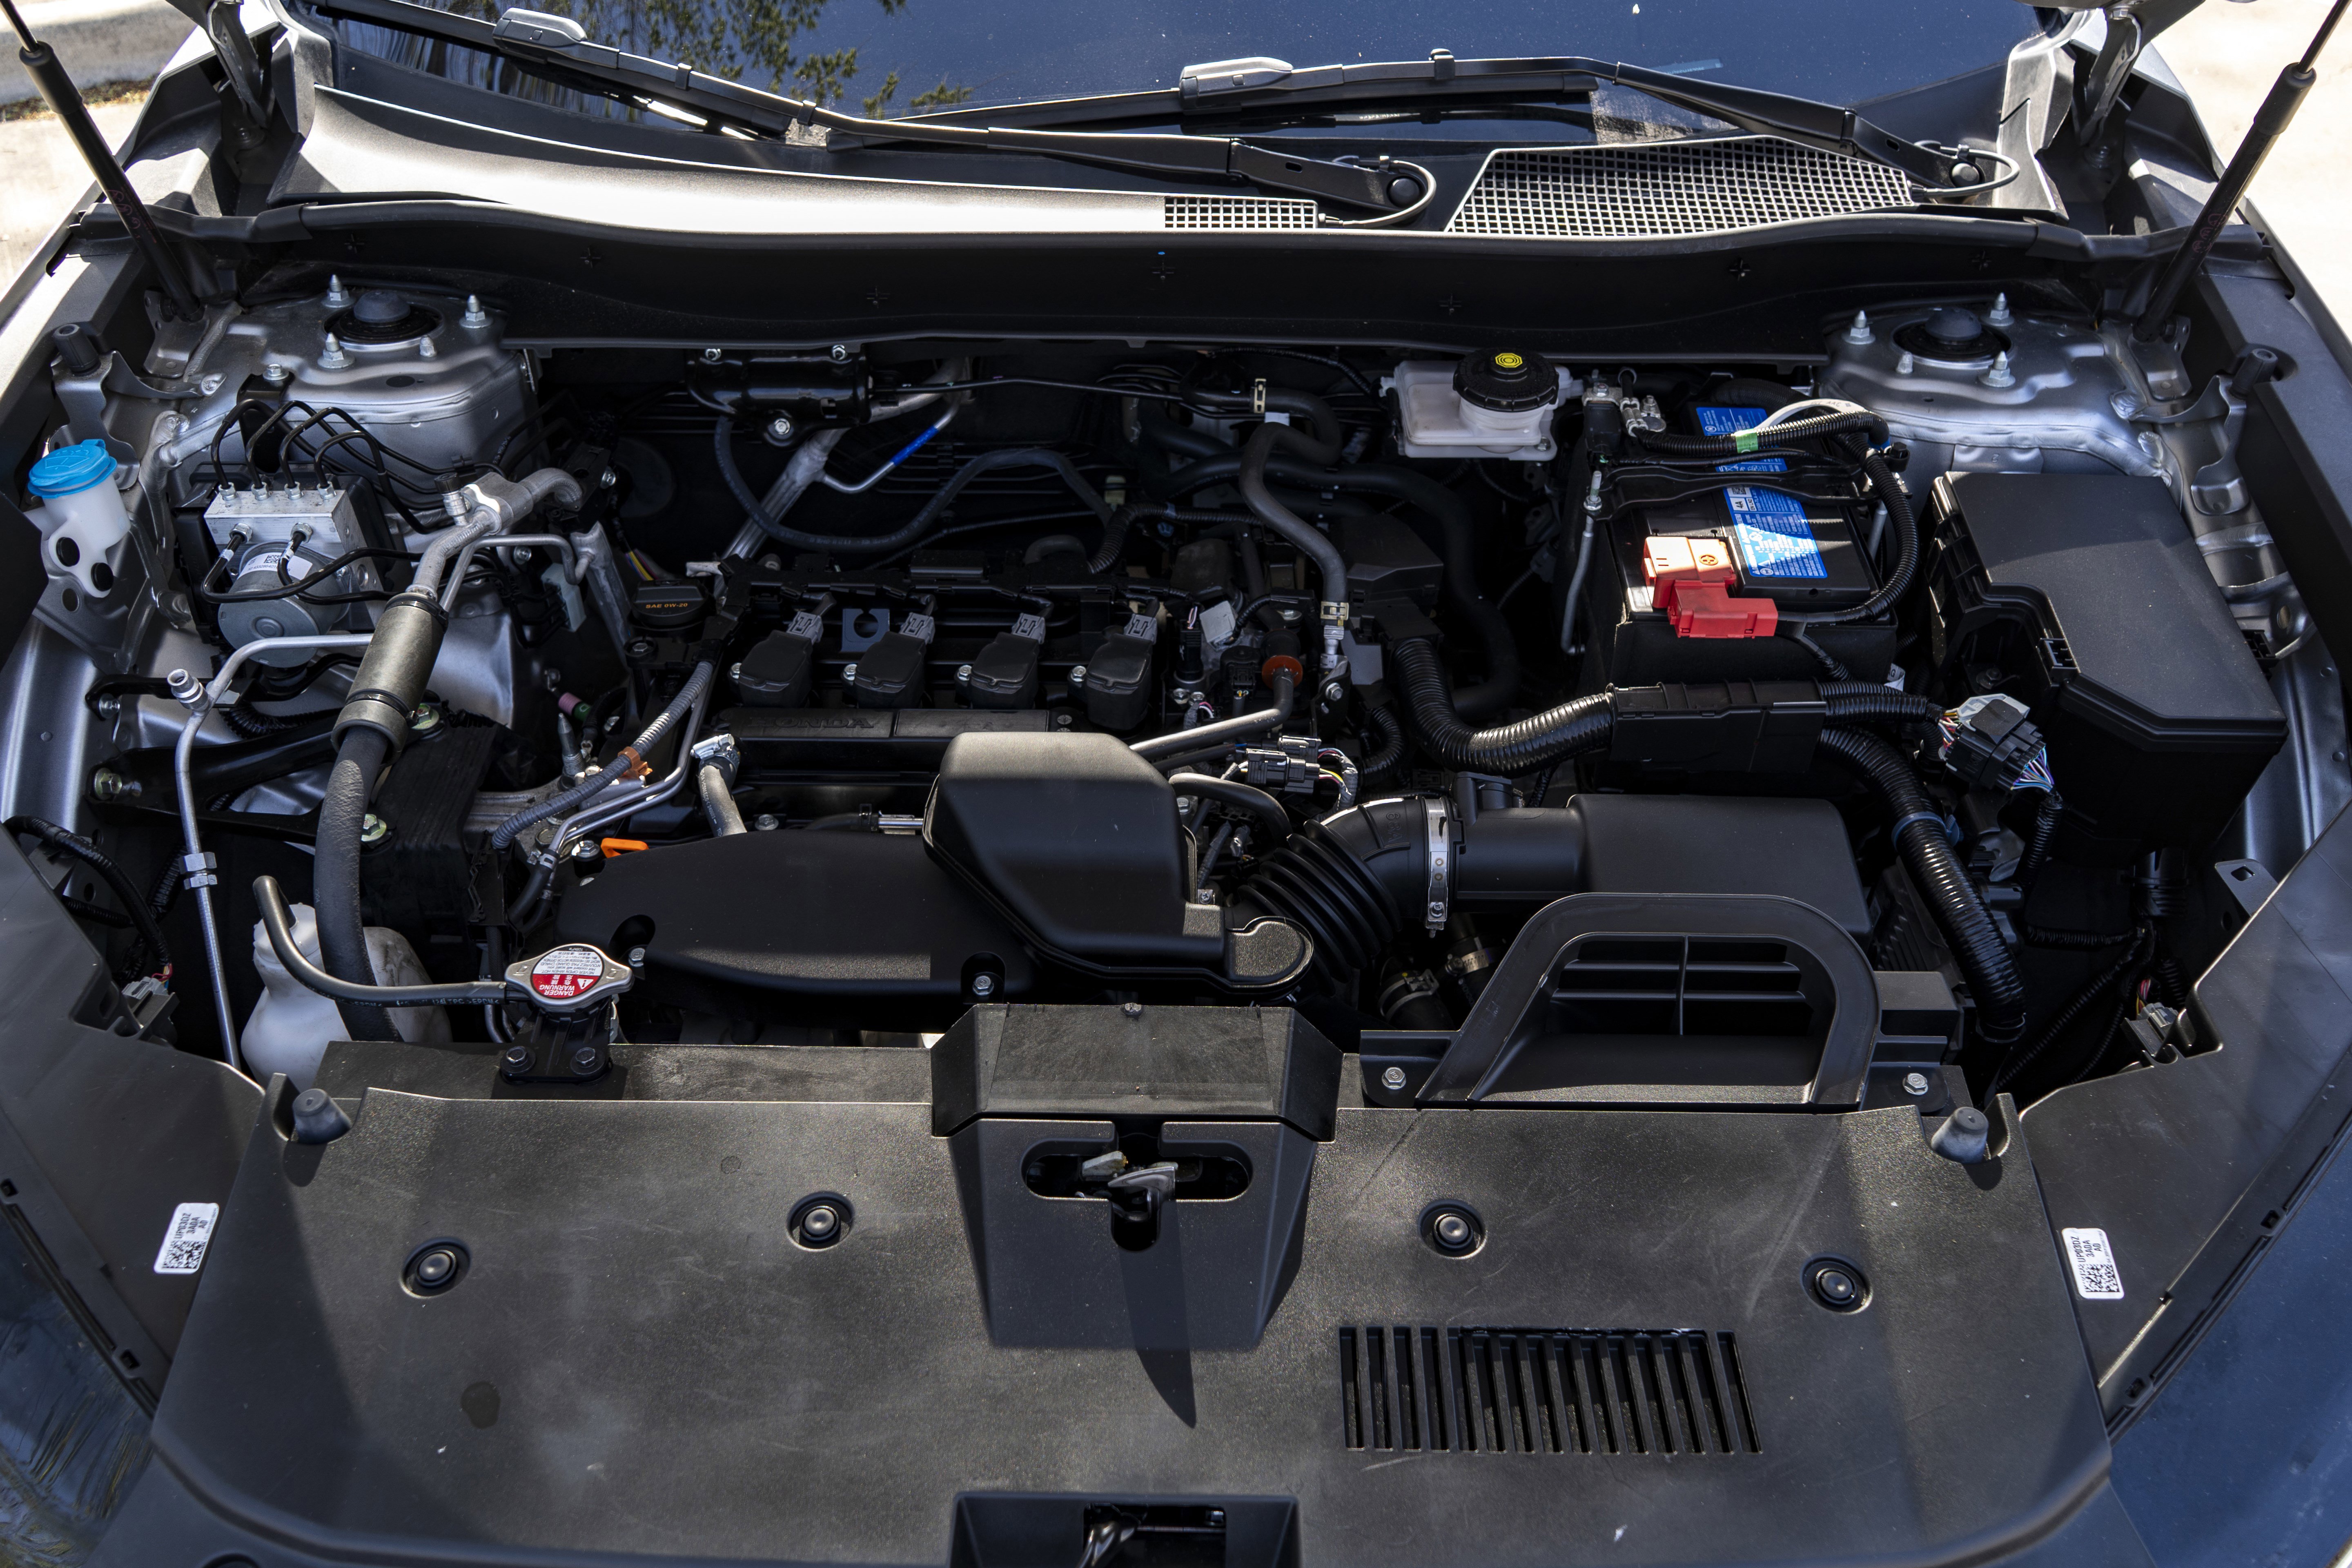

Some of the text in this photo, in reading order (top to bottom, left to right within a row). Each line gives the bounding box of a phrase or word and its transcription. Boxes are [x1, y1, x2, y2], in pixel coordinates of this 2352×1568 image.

[748, 716, 874, 729] HONDA
[1386, 812, 1402, 843] 68A
[2070, 1236, 2086, 1263] UP03DZ
